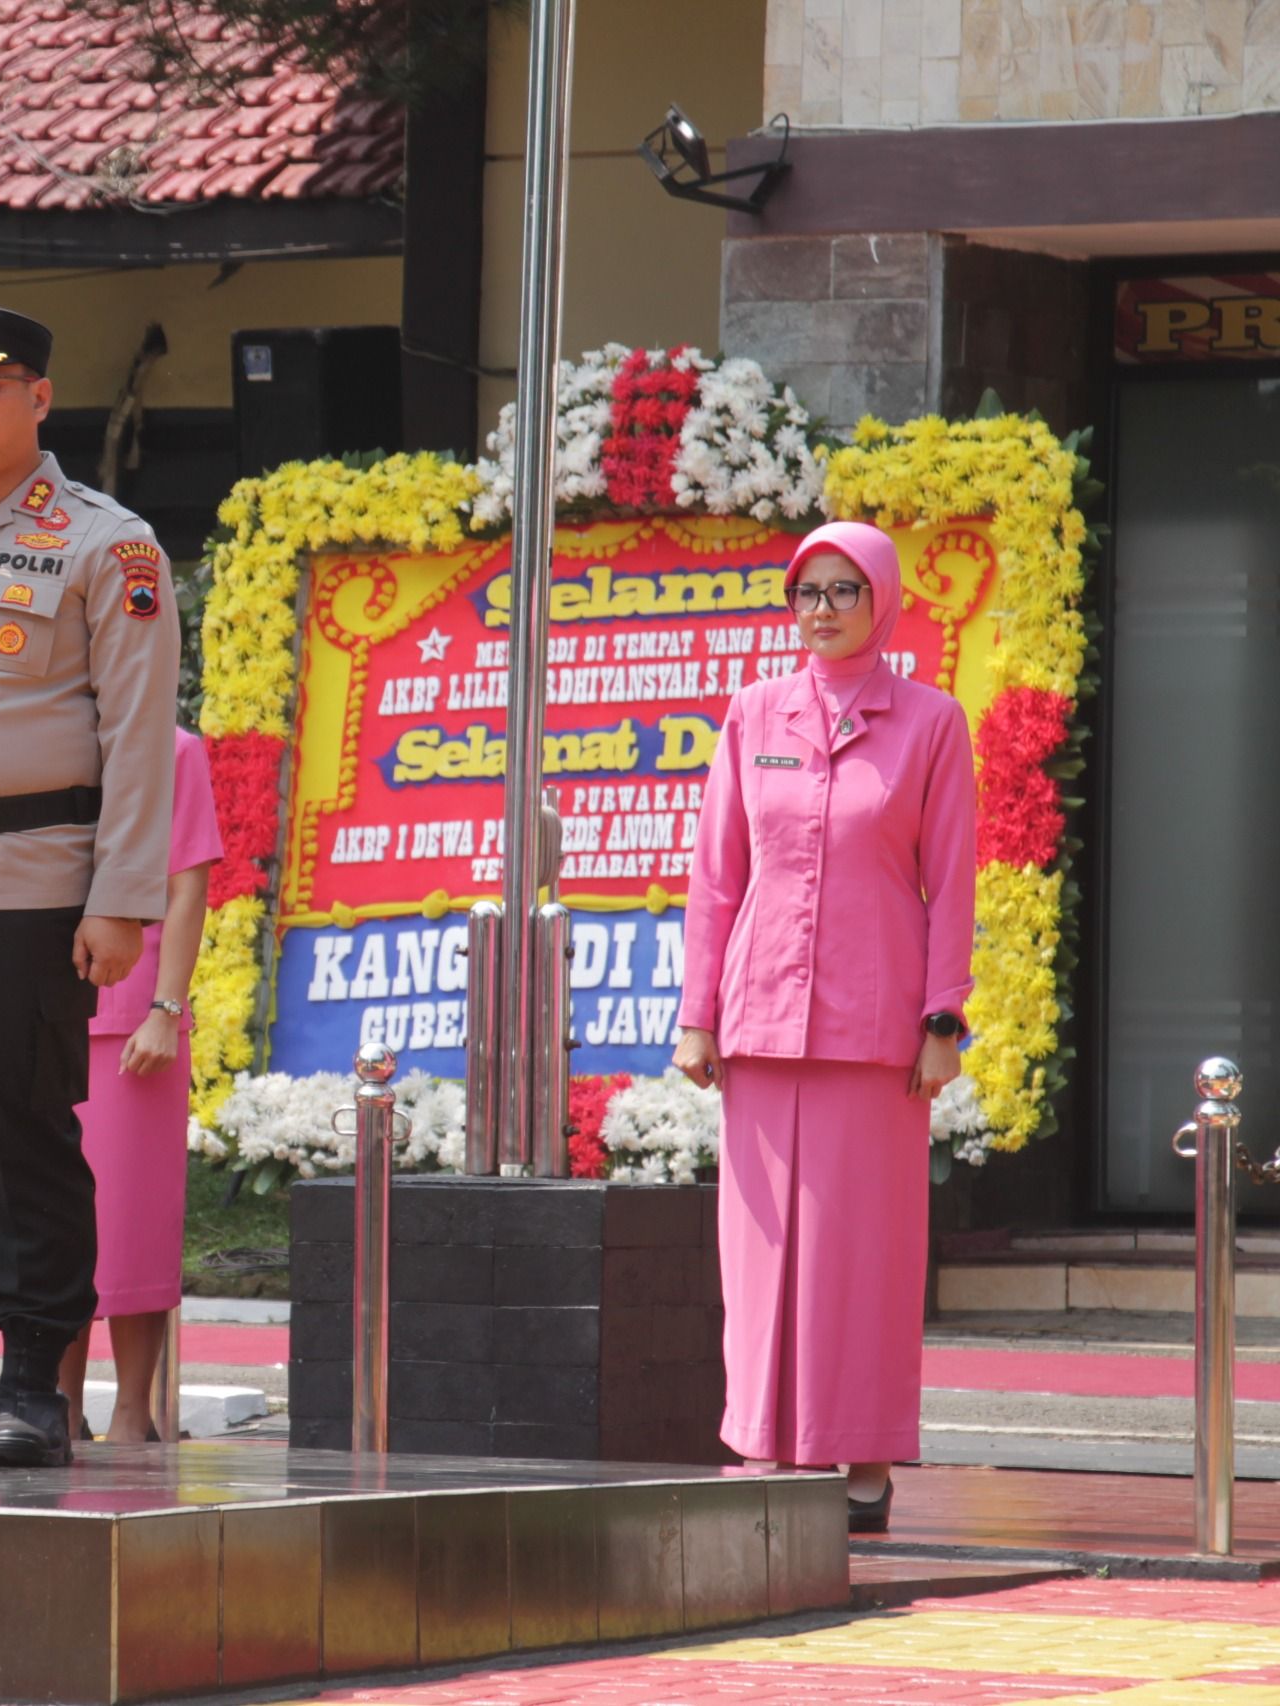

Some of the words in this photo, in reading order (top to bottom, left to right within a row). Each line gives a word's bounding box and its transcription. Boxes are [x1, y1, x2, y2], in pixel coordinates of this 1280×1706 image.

[485, 566, 787, 627] Selama
[583, 634, 607, 662] DI
[613, 629, 695, 660] TEMPAT
[705, 626, 755, 656] YANG
[378, 675, 441, 716] AKBP
[573, 783, 703, 815] PURWAKAR
[329, 824, 392, 864] AKBP
[395, 824, 409, 861] I
[410, 820, 473, 860] DEWA
[605, 813, 675, 851] ANOM
[559, 853, 656, 880] AHABAT
[307, 925, 468, 1001] KANG
